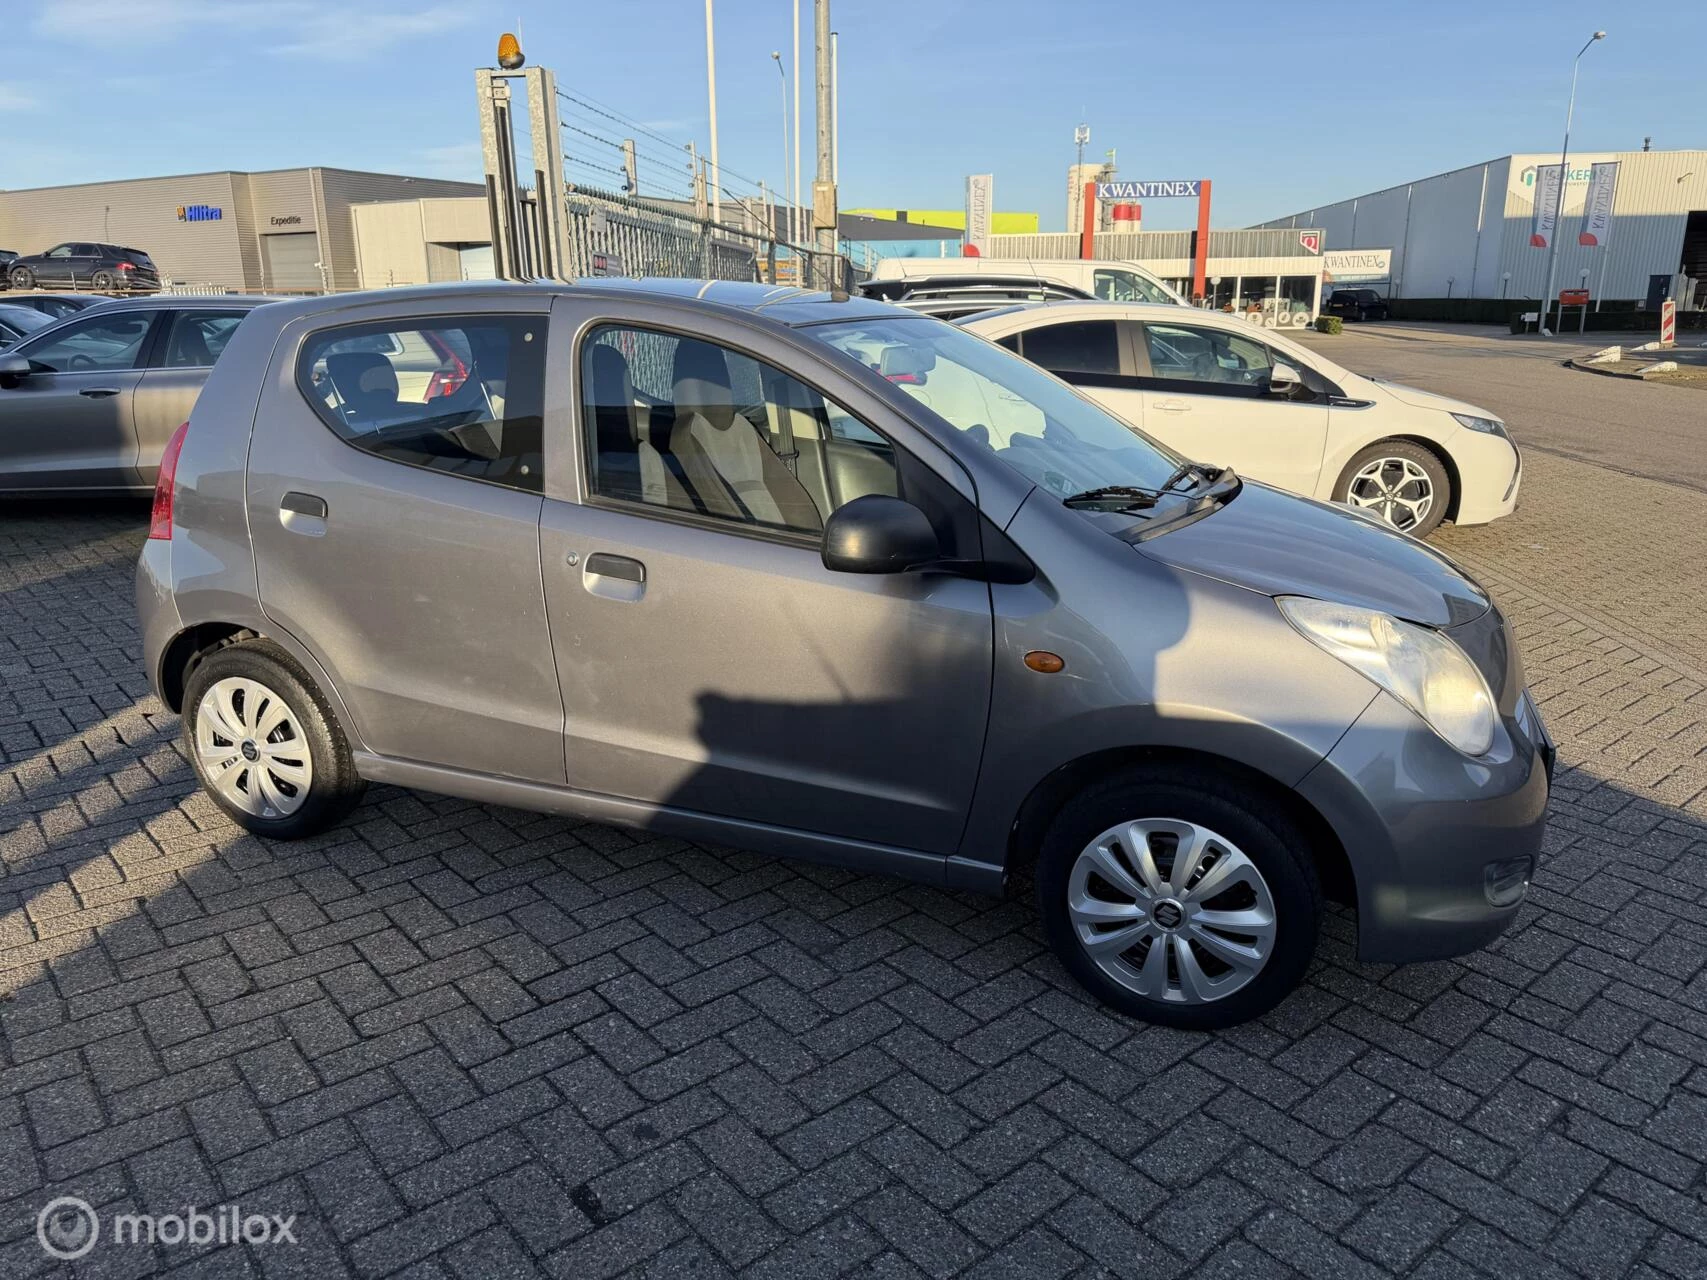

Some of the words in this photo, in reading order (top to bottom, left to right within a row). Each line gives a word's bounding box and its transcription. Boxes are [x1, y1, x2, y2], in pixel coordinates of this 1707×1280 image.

[1098, 181, 1197, 198] KWANTINEX
[187, 205, 222, 221] Hiltra
[270, 216, 301, 227] Expeditie
[1323, 255, 1380, 269] KWANTINEX
